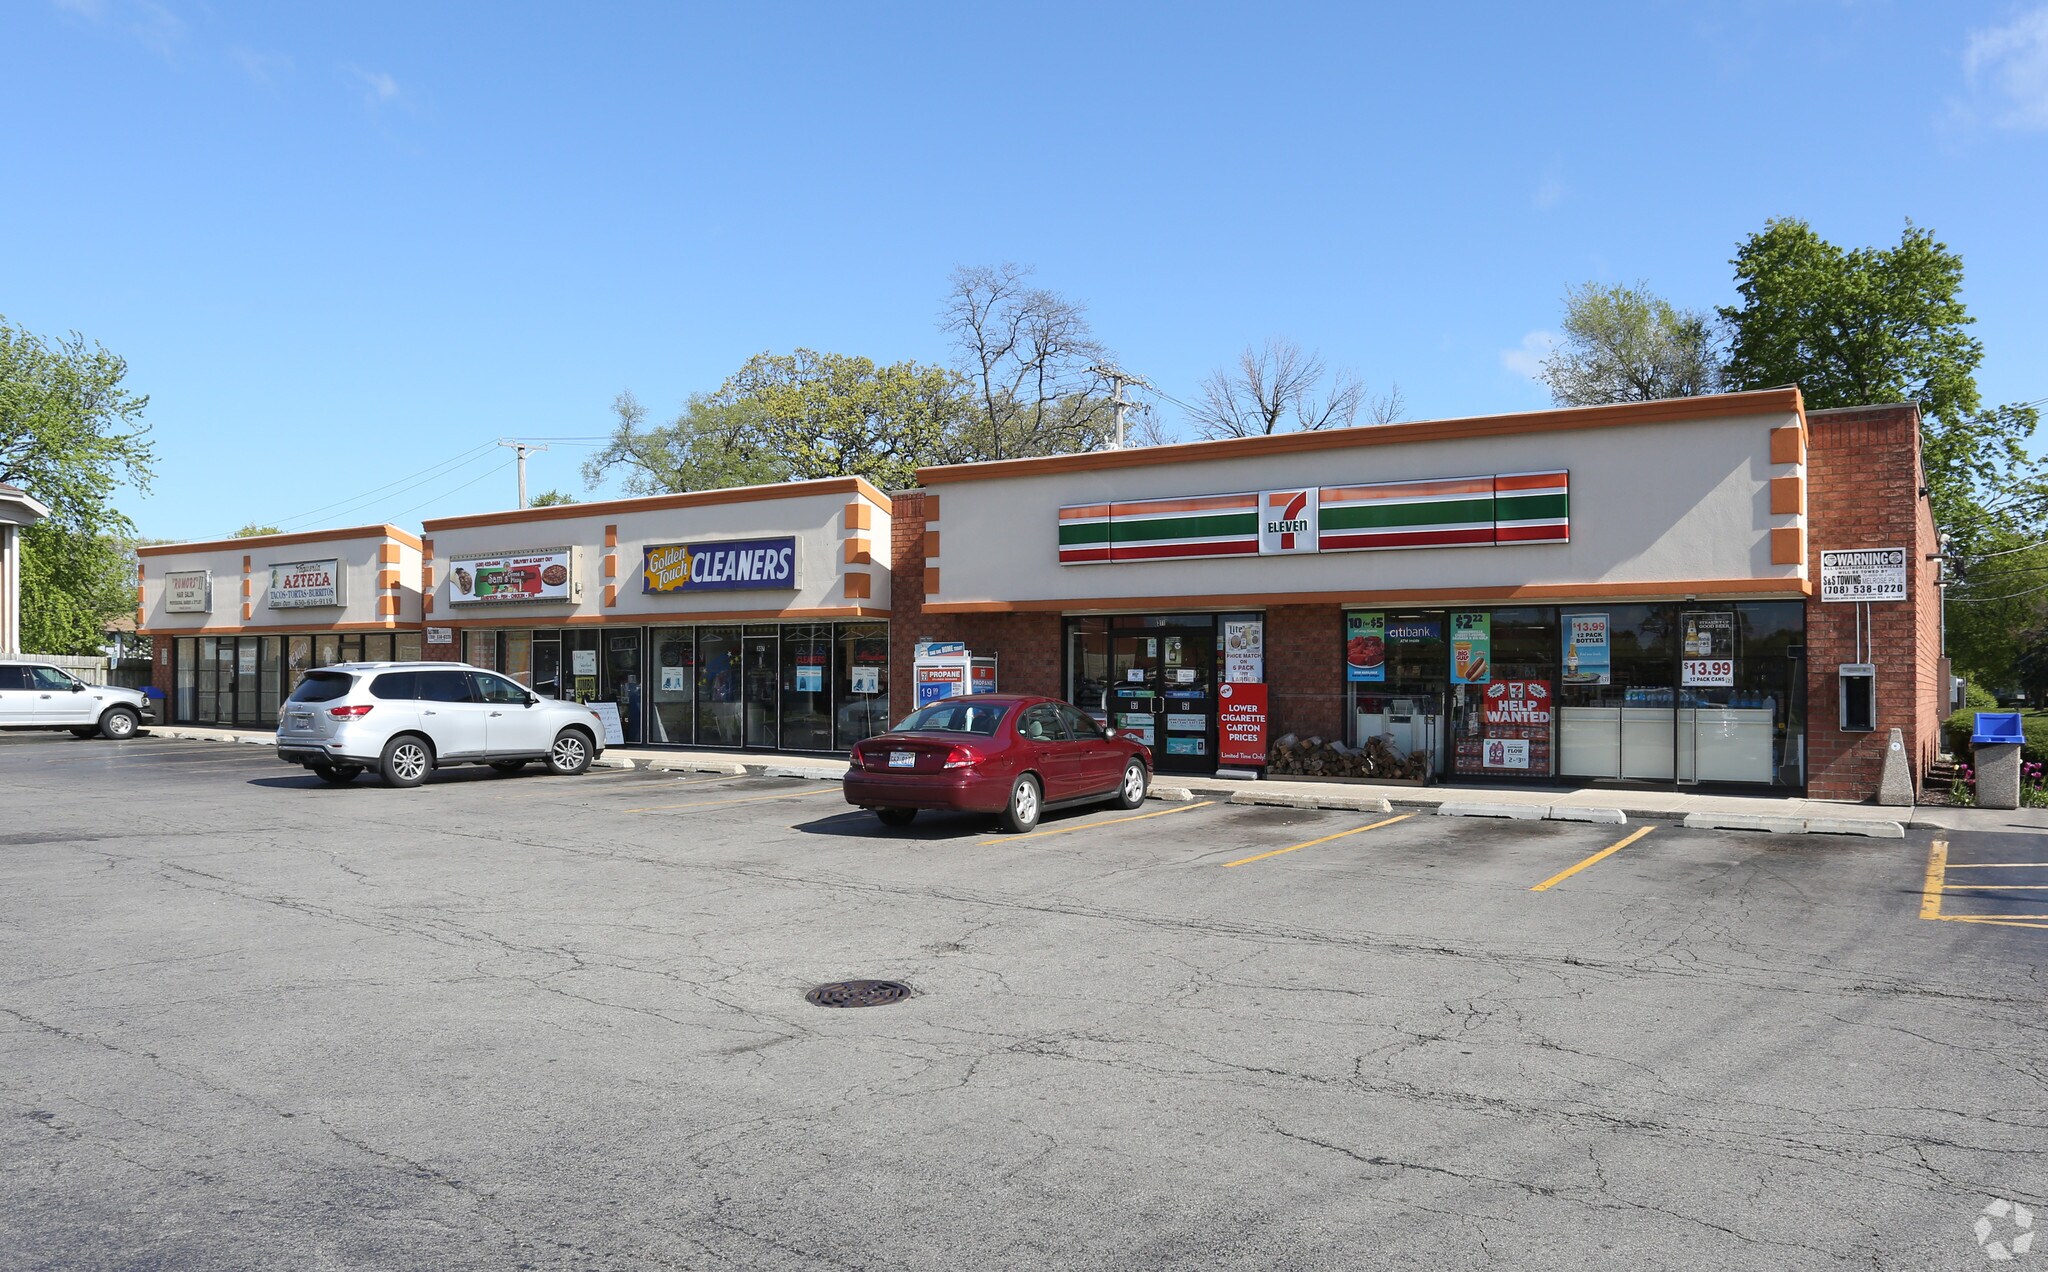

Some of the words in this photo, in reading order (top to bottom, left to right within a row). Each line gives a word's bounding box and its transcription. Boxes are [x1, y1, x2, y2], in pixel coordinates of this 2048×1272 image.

[1269, 491, 1307, 549] 7
[650, 547, 686, 573] Golden
[1837, 552, 1889, 566] WARNING
[691, 547, 792, 583] CLEANERS
[283, 572, 331, 588] AZTECA
[488, 573, 508, 584] Sam's
[656, 561, 688, 589] Touch
[1823, 575, 1836, 585] S&S
[1837, 575, 1861, 585] TOWING
[270, 590, 286, 599] TACOS
[288, 589, 306, 598] TORTAS
[309, 588, 334, 597] BURRITOS
[1824, 586, 1848, 594] (708)
[1854, 585, 1903, 593] 538-0220
[1348, 617, 1362, 628] 10
[1370, 617, 1384, 628] $5
[1573, 622, 1605, 631] $13.99
[1389, 627, 1430, 637] citibank
[1684, 662, 1731, 675] $13.99
[1498, 700, 1538, 711] HELP
[1221, 714, 1266, 722] CIGARETTE
[1487, 711, 1550, 723] WANTED
[1226, 724, 1260, 732] CARTON
